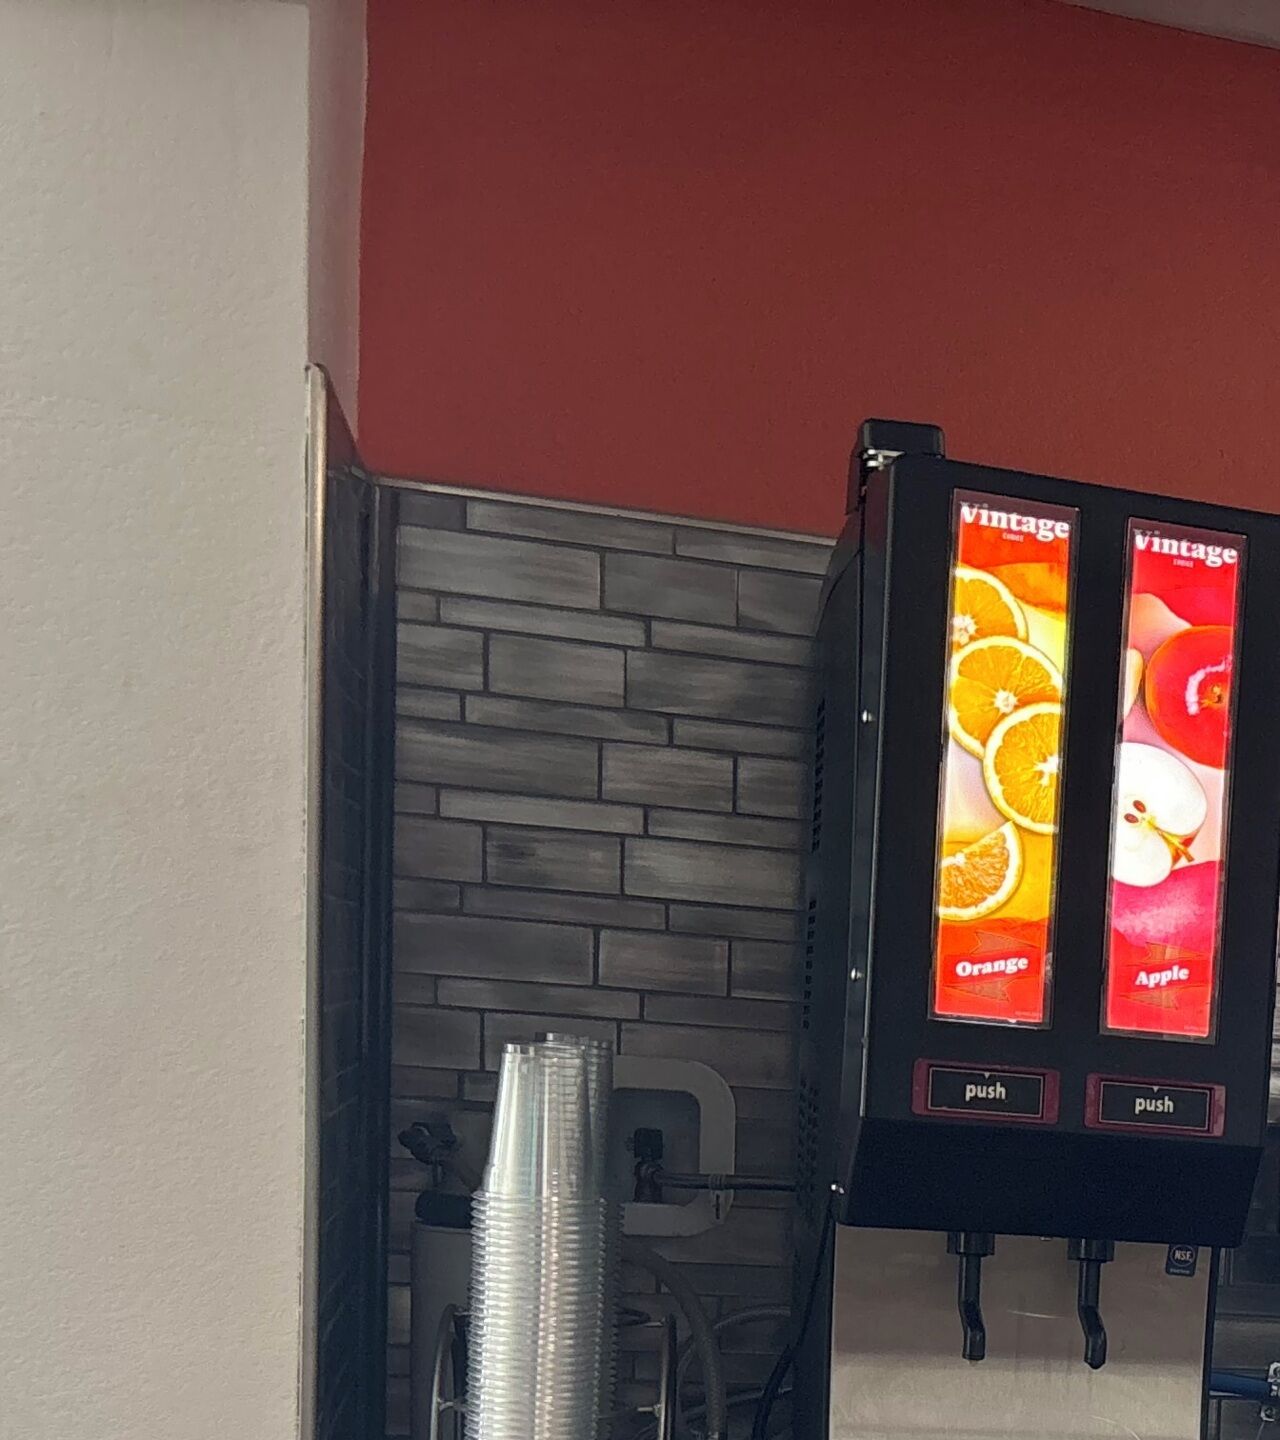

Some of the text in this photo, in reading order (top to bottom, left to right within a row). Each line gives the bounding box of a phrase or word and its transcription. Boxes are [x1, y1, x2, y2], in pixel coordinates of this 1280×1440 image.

[960, 502, 1070, 542] Vintage
[1134, 529, 1239, 567] Vintage
[955, 956, 1029, 977] Orange
[1135, 965, 1190, 988] Apple
[965, 1082, 1007, 1101] push
[1134, 1096, 1175, 1115] push
